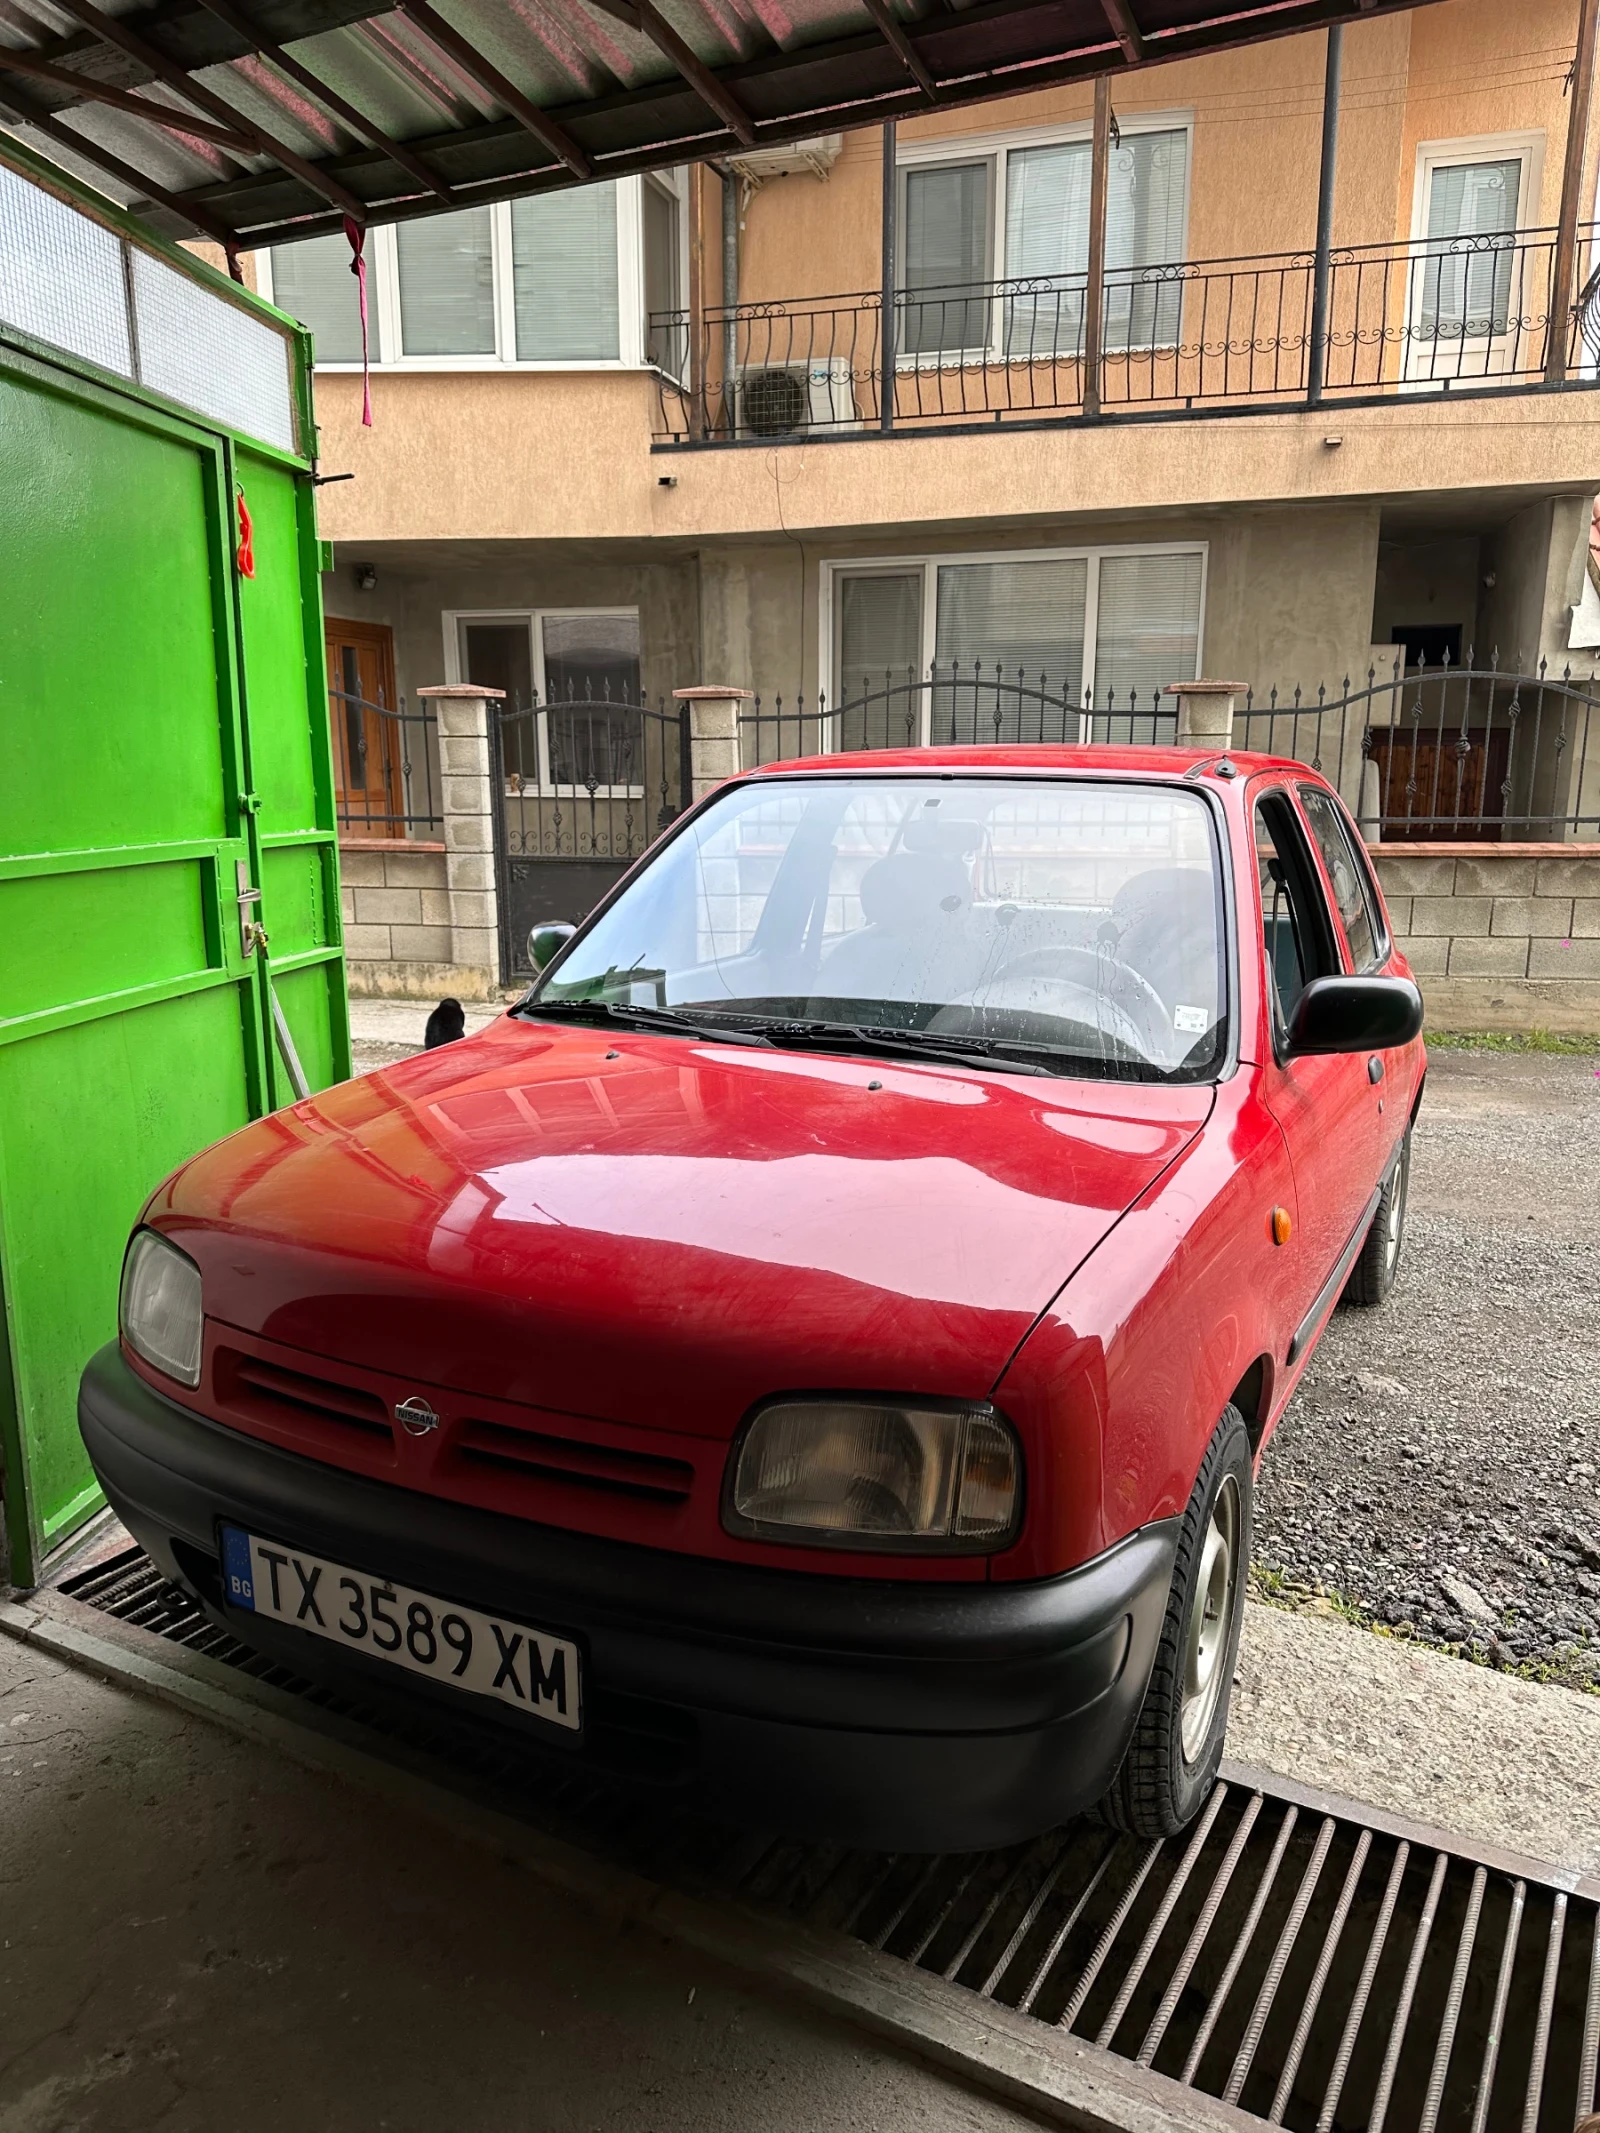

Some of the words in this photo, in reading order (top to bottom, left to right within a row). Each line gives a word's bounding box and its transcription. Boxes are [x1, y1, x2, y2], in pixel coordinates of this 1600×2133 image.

[398, 1409, 433, 1425] NISSAN
[231, 1575, 251, 1598] BG
[257, 1547, 326, 1627] TX
[339, 1577, 473, 1677] 3589
[489, 1624, 567, 1715] XM
